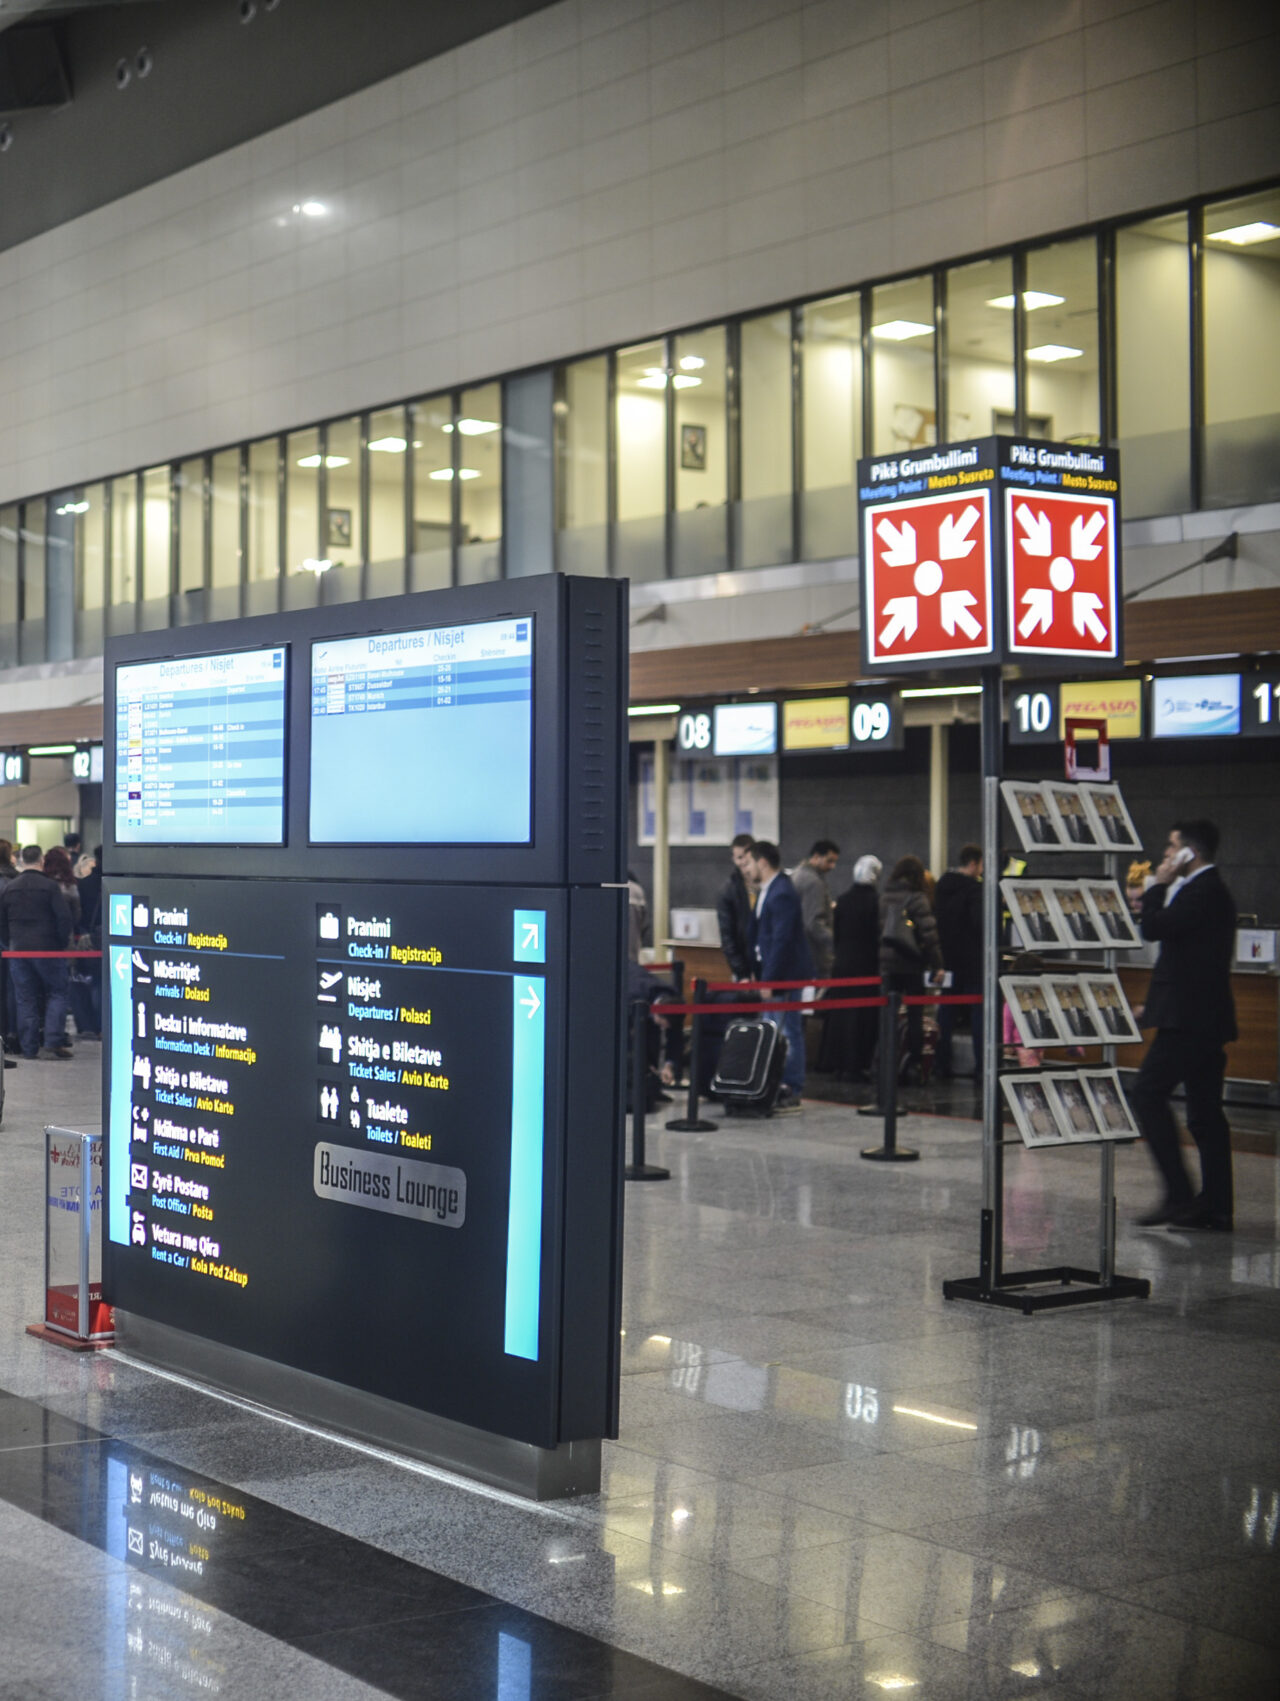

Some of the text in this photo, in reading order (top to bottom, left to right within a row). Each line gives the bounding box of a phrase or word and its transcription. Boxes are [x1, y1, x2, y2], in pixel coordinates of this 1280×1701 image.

[871, 446, 978, 482] Pikë Grumbullimi
[1010, 444, 1105, 473] Pikë Grumbullimi
[860, 483, 898, 500] Meeting
[898, 478, 921, 496] Point
[927, 473, 958, 490] Mesto
[958, 467, 994, 486] Susreta
[1001, 465, 1036, 486] Meeting
[1036, 468, 1058, 484] Point
[1062, 473, 1087, 490] Mesto
[1087, 476, 1118, 492] Susreta
[368, 634, 424, 655] Departures
[433, 630, 465, 648] Nisjet
[159, 662, 203, 680] Departures
[210, 658, 234, 674] Nisjet
[1015, 693, 1052, 732] 10
[1065, 699, 1138, 714] PEGASUS
[679, 713, 711, 749] 08
[852, 702, 891, 741] 09
[5, 756, 22, 780] 01
[73, 751, 90, 777] 02
[154, 908, 188, 926] Pranimi
[347, 917, 391, 938] Pranimi
[154, 931, 182, 945] Check-in
[187, 933, 228, 950] Registracija
[348, 943, 384, 959] Check-in
[391, 944, 442, 966] Registracija
[155, 985, 180, 998] Arrivals
[185, 987, 210, 1001] Dolasci
[347, 976, 381, 1002] Nisjet
[155, 1014, 181, 1032] Desku
[189, 1017, 247, 1041] Informatave
[348, 1003, 393, 1022] Departures
[400, 1007, 431, 1025] Polasci
[155, 1037, 192, 1054] Information
[194, 1042, 210, 1056] Desk
[215, 1045, 256, 1065] Informacije
[348, 1036, 442, 1067] Shitja e Biletave
[155, 1066, 229, 1094] Shitja e Biletave
[348, 1062, 372, 1079] Ticket
[374, 1067, 396, 1083] Sales
[401, 1070, 421, 1086] Avio
[422, 1074, 449, 1090] Karte
[155, 1089, 174, 1105] Ticket
[175, 1093, 192, 1108] Sales
[197, 1097, 213, 1110] Avio
[214, 1100, 234, 1115] Karte
[366, 1098, 408, 1125] Tualete
[154, 1118, 219, 1148] Ndihma e Parë
[366, 1125, 393, 1144] Toilets
[400, 1130, 432, 1151] Toaleti
[153, 1142, 168, 1157] First
[169, 1145, 180, 1160] Aid
[184, 1148, 200, 1163] Prva
[201, 1150, 225, 1168] Pomoć
[152, 1171, 209, 1201] Zyrë Postare
[320, 1150, 458, 1220] Business Lounge
[152, 1195, 167, 1209] Post
[167, 1198, 187, 1215] Office
[192, 1204, 213, 1221] Pošta
[151, 1223, 220, 1258] Vetura me Qira
[152, 1247, 167, 1261] Rent
[173, 1252, 185, 1267] Car
[191, 1257, 207, 1275] Kola
[209, 1262, 224, 1278] Pod
[224, 1266, 248, 1288] Zakup
